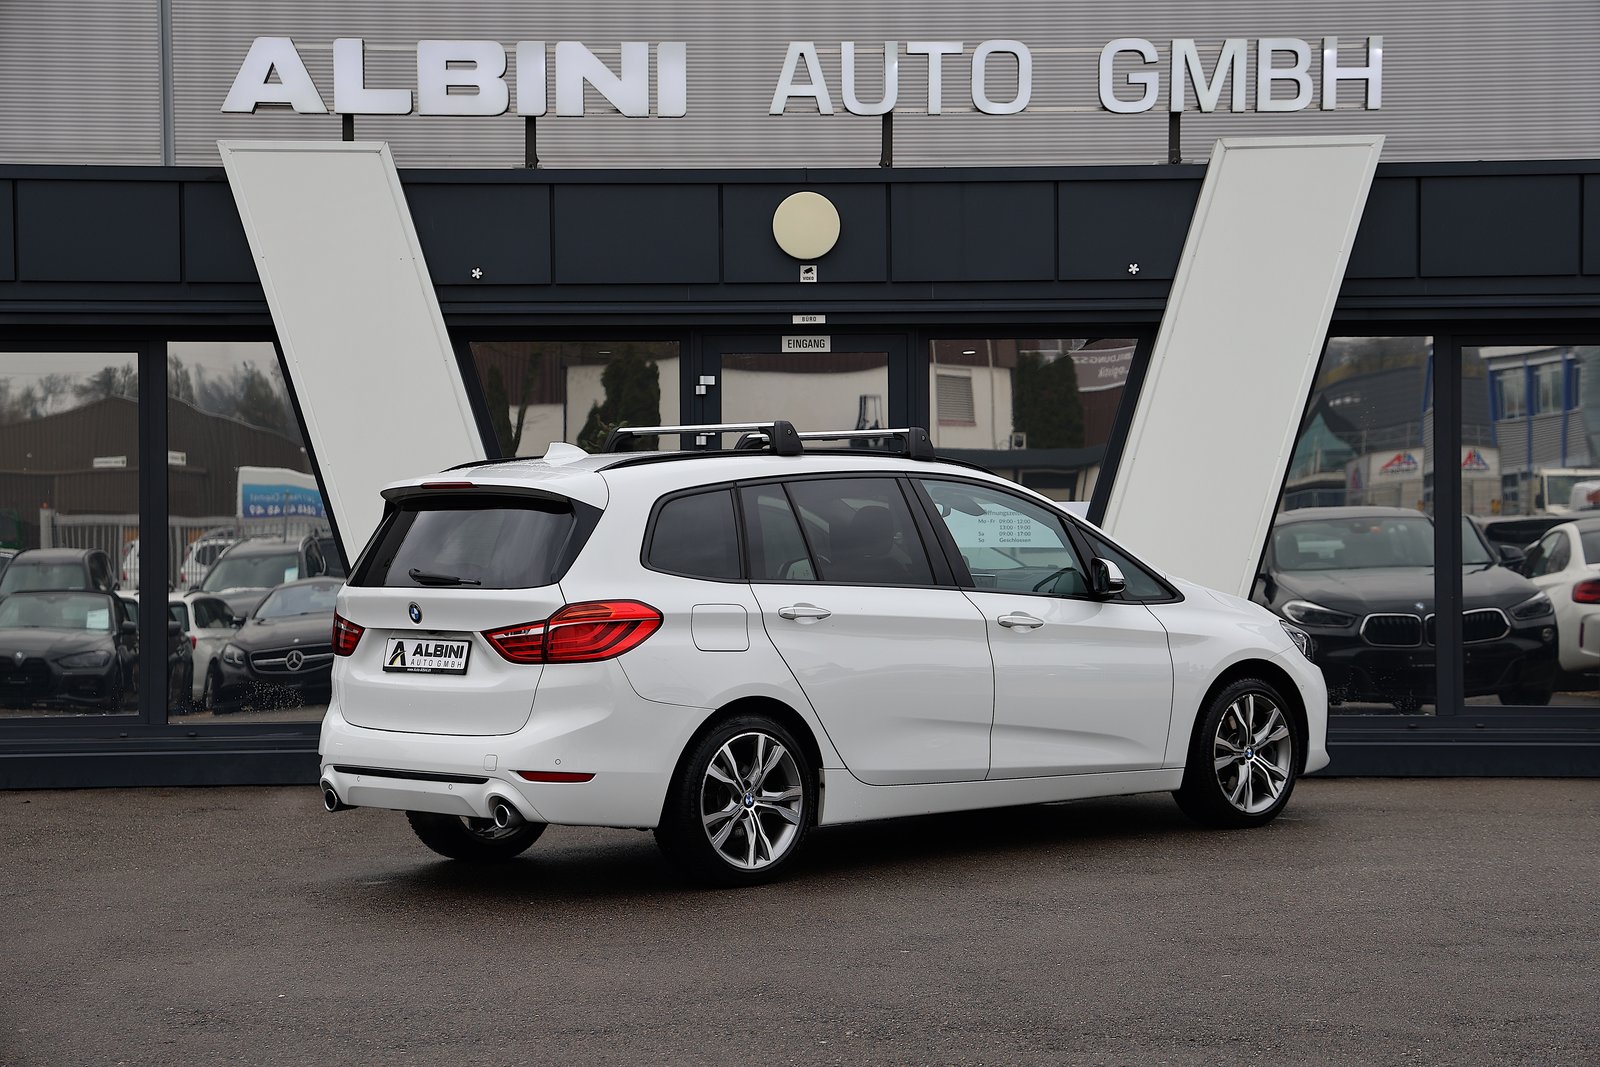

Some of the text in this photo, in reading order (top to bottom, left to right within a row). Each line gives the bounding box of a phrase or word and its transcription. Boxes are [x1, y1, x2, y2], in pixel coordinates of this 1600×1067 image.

[221, 36, 1384, 118] ALBINI AUTO GMBH
[787, 339, 826, 349] EINGANG
[412, 643, 465, 659] ALBINI
[410, 659, 462, 669] AUTO GMBH
